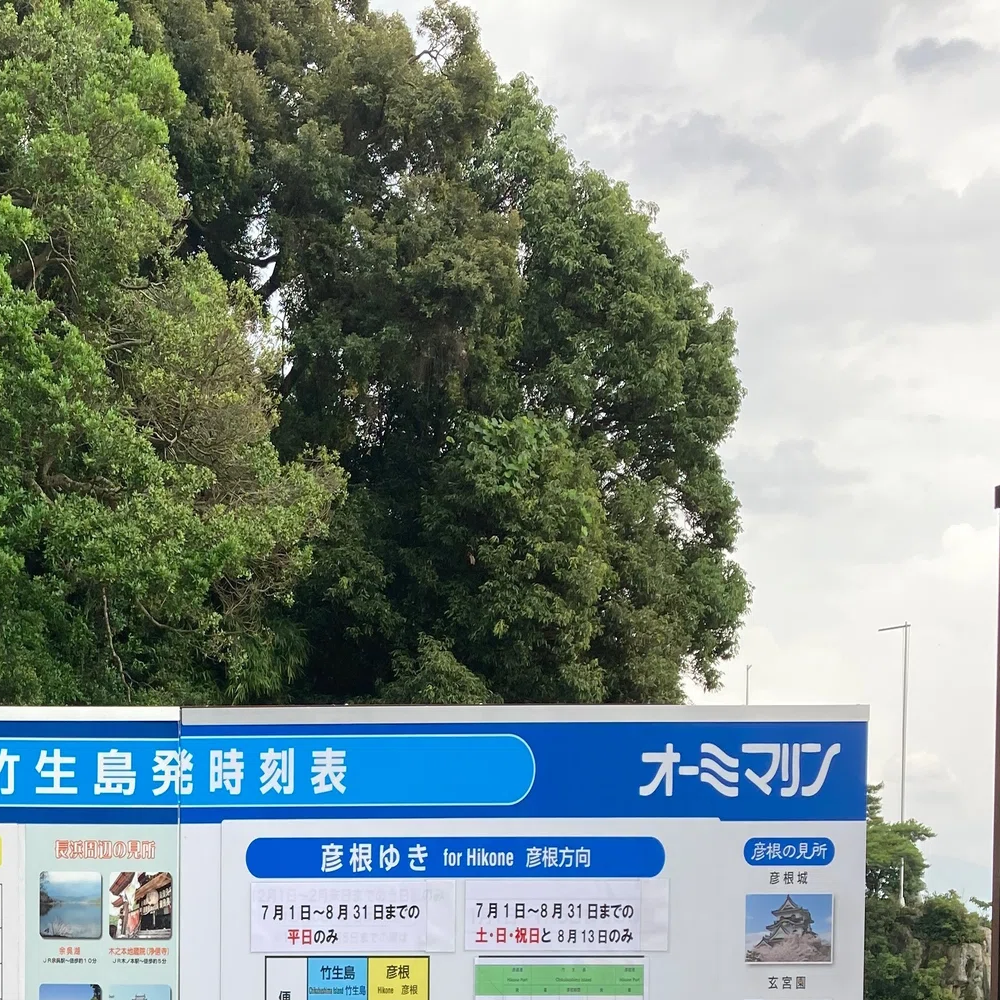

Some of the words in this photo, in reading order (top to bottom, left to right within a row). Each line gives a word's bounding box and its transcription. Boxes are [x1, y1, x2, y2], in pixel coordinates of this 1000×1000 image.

[639, 743, 841, 797] オーミマリン
[54, 839, 156, 859] 長浜周辺の見所
[443, 848, 462, 866] for
[466, 848, 514, 866] Hikone
[526, 846, 591, 868] 彦根方向
[751, 842, 828, 861] 彦根の見所
[320, 843, 429, 873] 彦根ゆき
[769, 871, 808, 885] 彦根城
[287, 929, 338, 945] 平日のみ
[320, 965, 355, 980] 竹生島
[386, 965, 410, 979] 彦根
[401, 985, 418, 995] 彦根
[768, 976, 806, 990] 玄宮園
